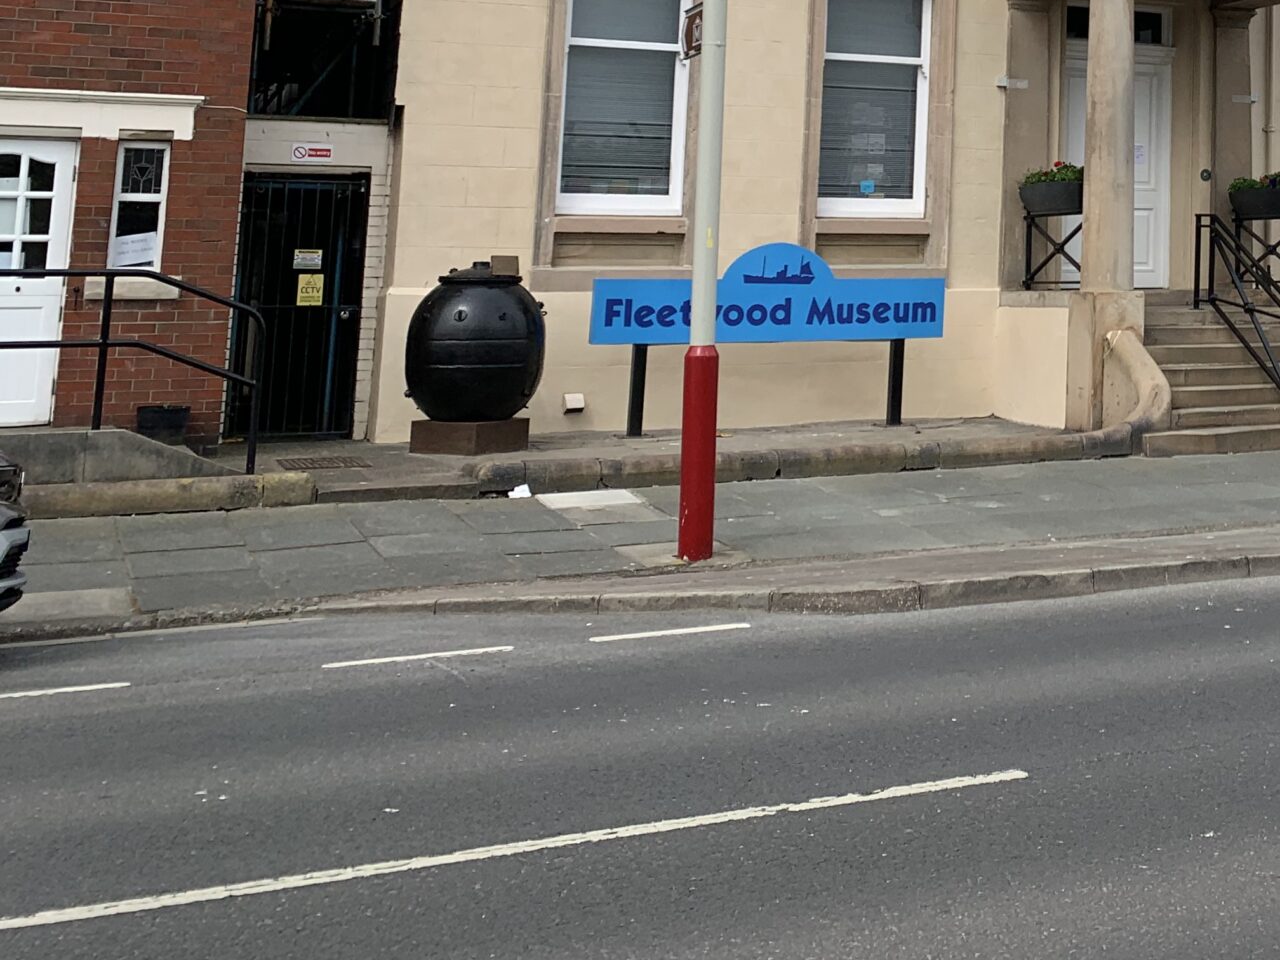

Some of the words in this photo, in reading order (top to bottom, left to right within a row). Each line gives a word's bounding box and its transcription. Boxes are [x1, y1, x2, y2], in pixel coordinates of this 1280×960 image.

[300, 286, 321, 295] CCTV
[604, 297, 791, 328] Fleetood
[805, 297, 937, 326] Museum
